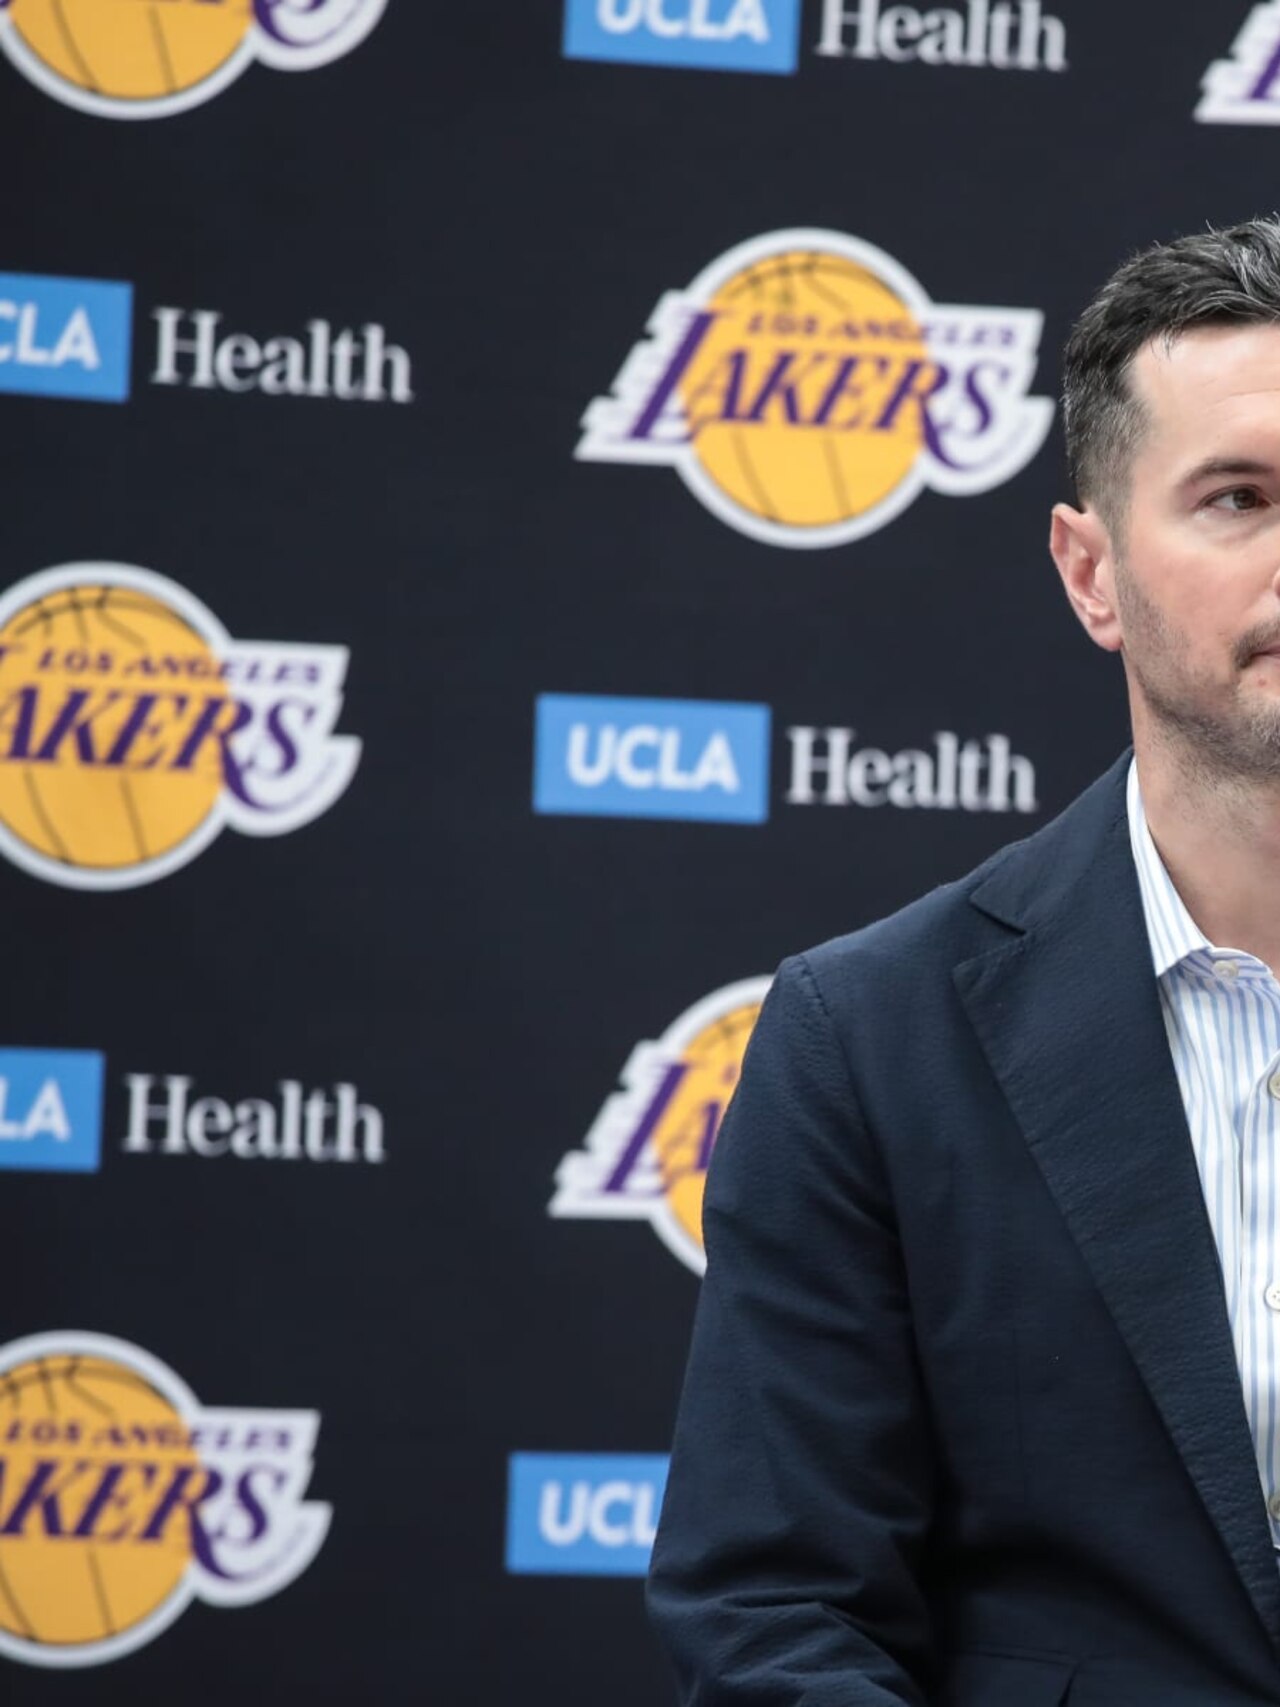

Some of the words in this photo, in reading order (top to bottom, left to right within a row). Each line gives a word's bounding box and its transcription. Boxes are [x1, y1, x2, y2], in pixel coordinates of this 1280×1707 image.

[597, 0, 770, 43] UCLA
[816, 0, 1067, 72] Health
[0, 299, 101, 370] LA
[152, 306, 414, 403] Health
[624, 310, 1018, 471] LAKERS
[38, 646, 114, 674] LOS
[124, 651, 322, 685] ANGELES
[0, 684, 322, 814] AKERS
[565, 723, 741, 793] UCLA
[787, 725, 1036, 814] Health
[0, 1076, 72, 1142] LA
[123, 1072, 385, 1163] Health
[0, 1457, 290, 1584] KERS
[537, 1478, 660, 1551] UCL
